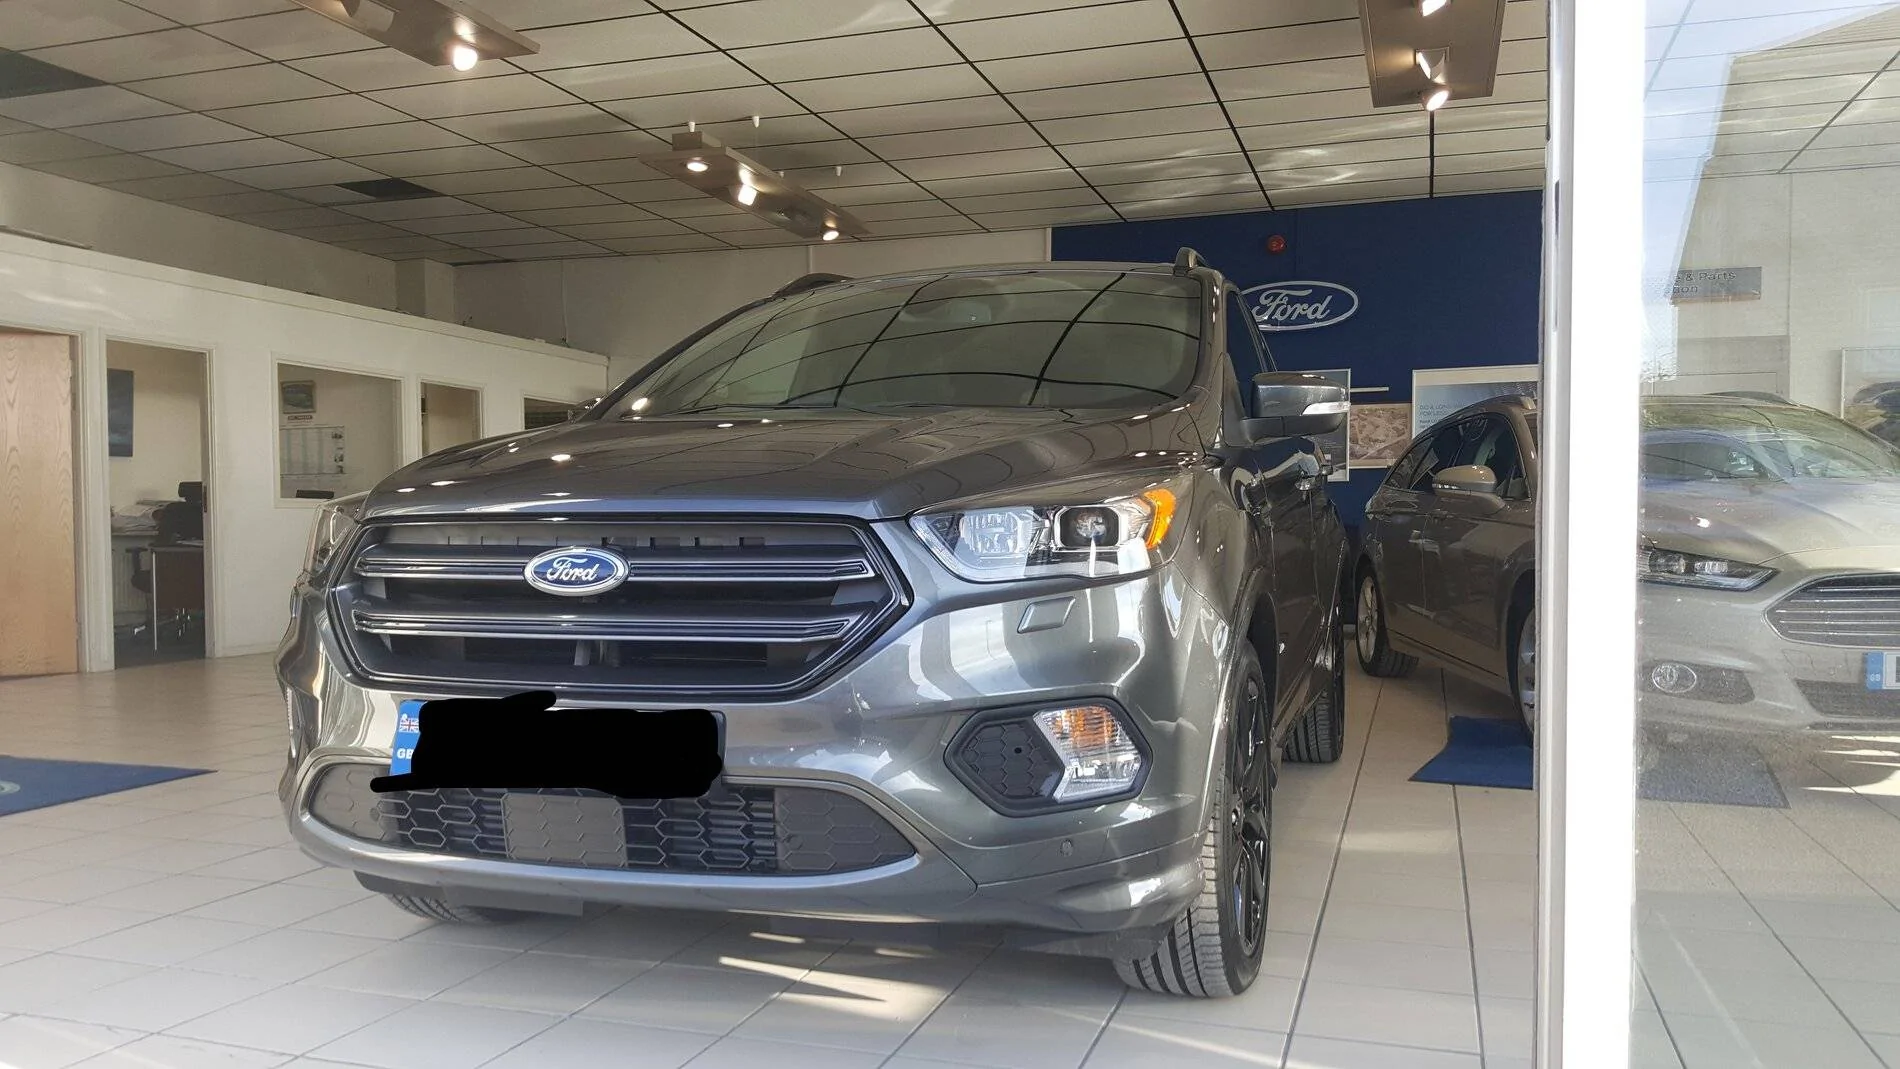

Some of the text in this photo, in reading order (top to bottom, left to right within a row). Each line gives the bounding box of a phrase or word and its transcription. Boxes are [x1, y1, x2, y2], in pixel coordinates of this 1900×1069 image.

[1699, 271, 1736, 281] Parts
[1251, 289, 1333, 322] Ford
[546, 556, 600, 582] Ford
[397, 748, 414, 759] GB
